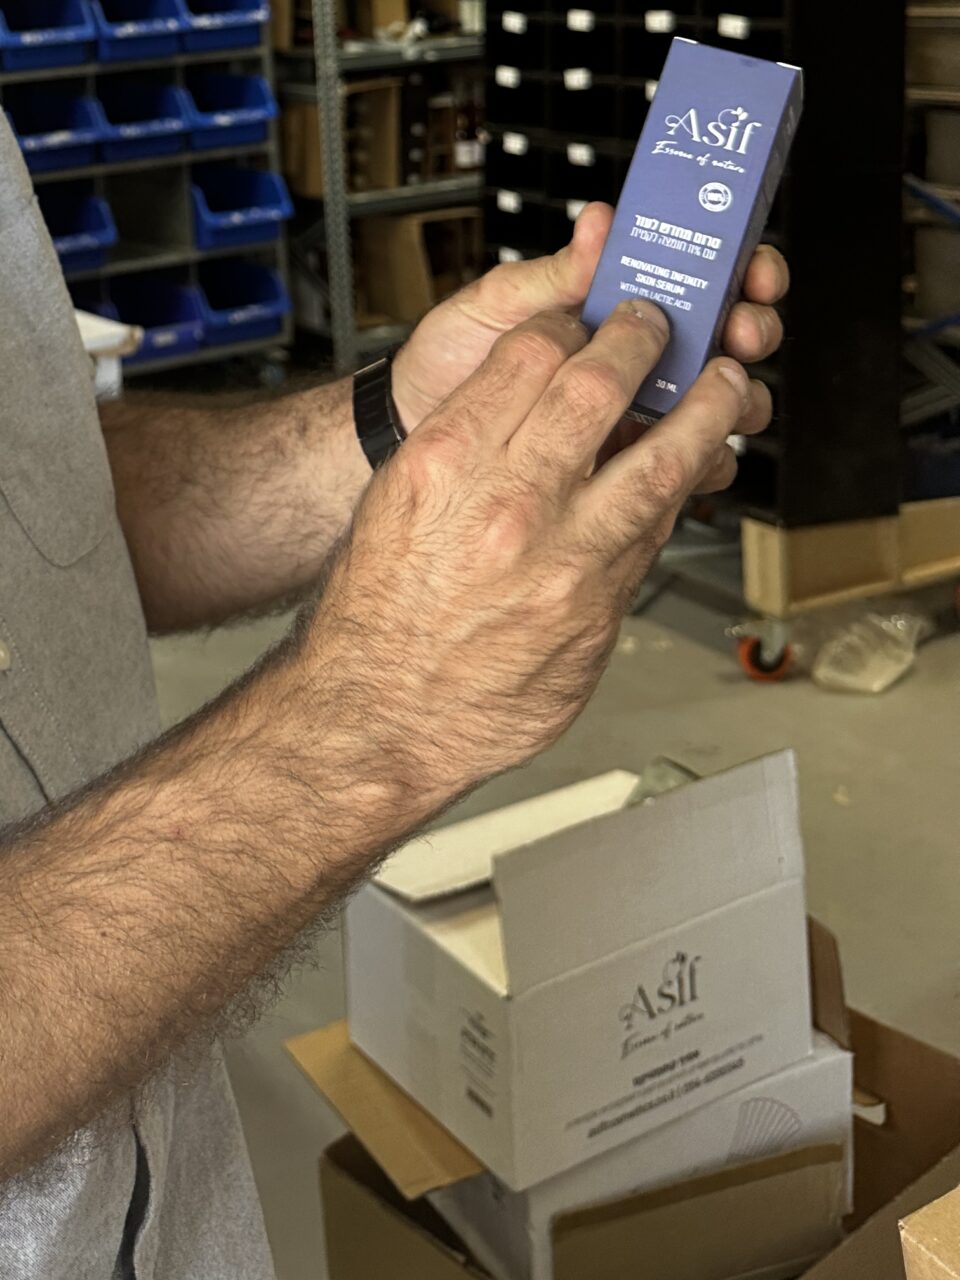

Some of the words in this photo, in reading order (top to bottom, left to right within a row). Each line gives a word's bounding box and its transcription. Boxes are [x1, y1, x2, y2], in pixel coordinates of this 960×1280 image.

[664, 106, 762, 155] Asif
[696, 153, 711, 167] of
[620, 255, 671, 279] RENOVATING
[670, 270, 709, 289] INFINITY
[635, 272, 657, 287] SKIN
[655, 278, 686, 296] SERUM
[620, 281, 639, 294] WITH
[649, 291, 674, 306] LACTIC
[674, 299, 692, 311] ACID
[618, 951, 702, 1031] Asif
